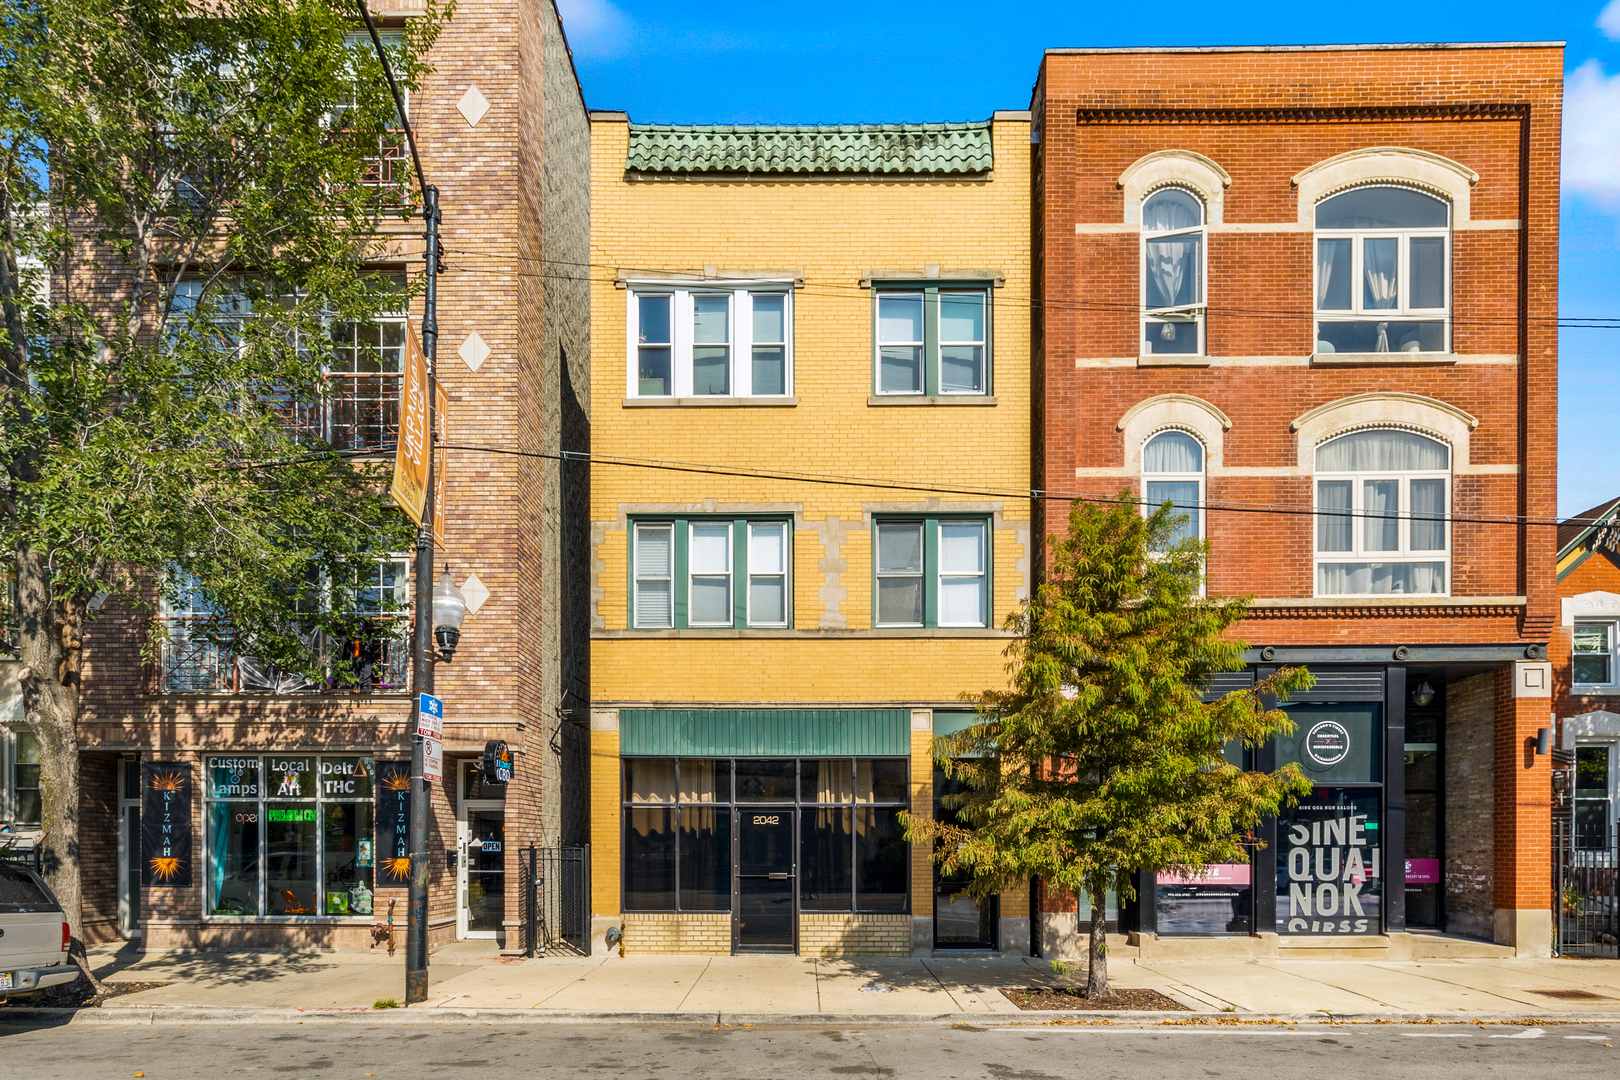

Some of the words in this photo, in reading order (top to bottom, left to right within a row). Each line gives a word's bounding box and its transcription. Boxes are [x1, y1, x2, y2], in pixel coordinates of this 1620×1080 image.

[404, 345, 419, 458] UKRAINIAN
[413, 390, 425, 466] VILLAGE
[209, 757, 259, 769] Custom
[272, 759, 310, 771] Local
[213, 784, 258, 797] Lamps
[277, 783, 302, 796] Art
[323, 781, 355, 794] THC
[163, 791, 171, 857] KIZMAH
[396, 791, 406, 857] KIZMAH
[753, 816, 779, 825] 2042
[483, 842, 500, 850] OPEN
